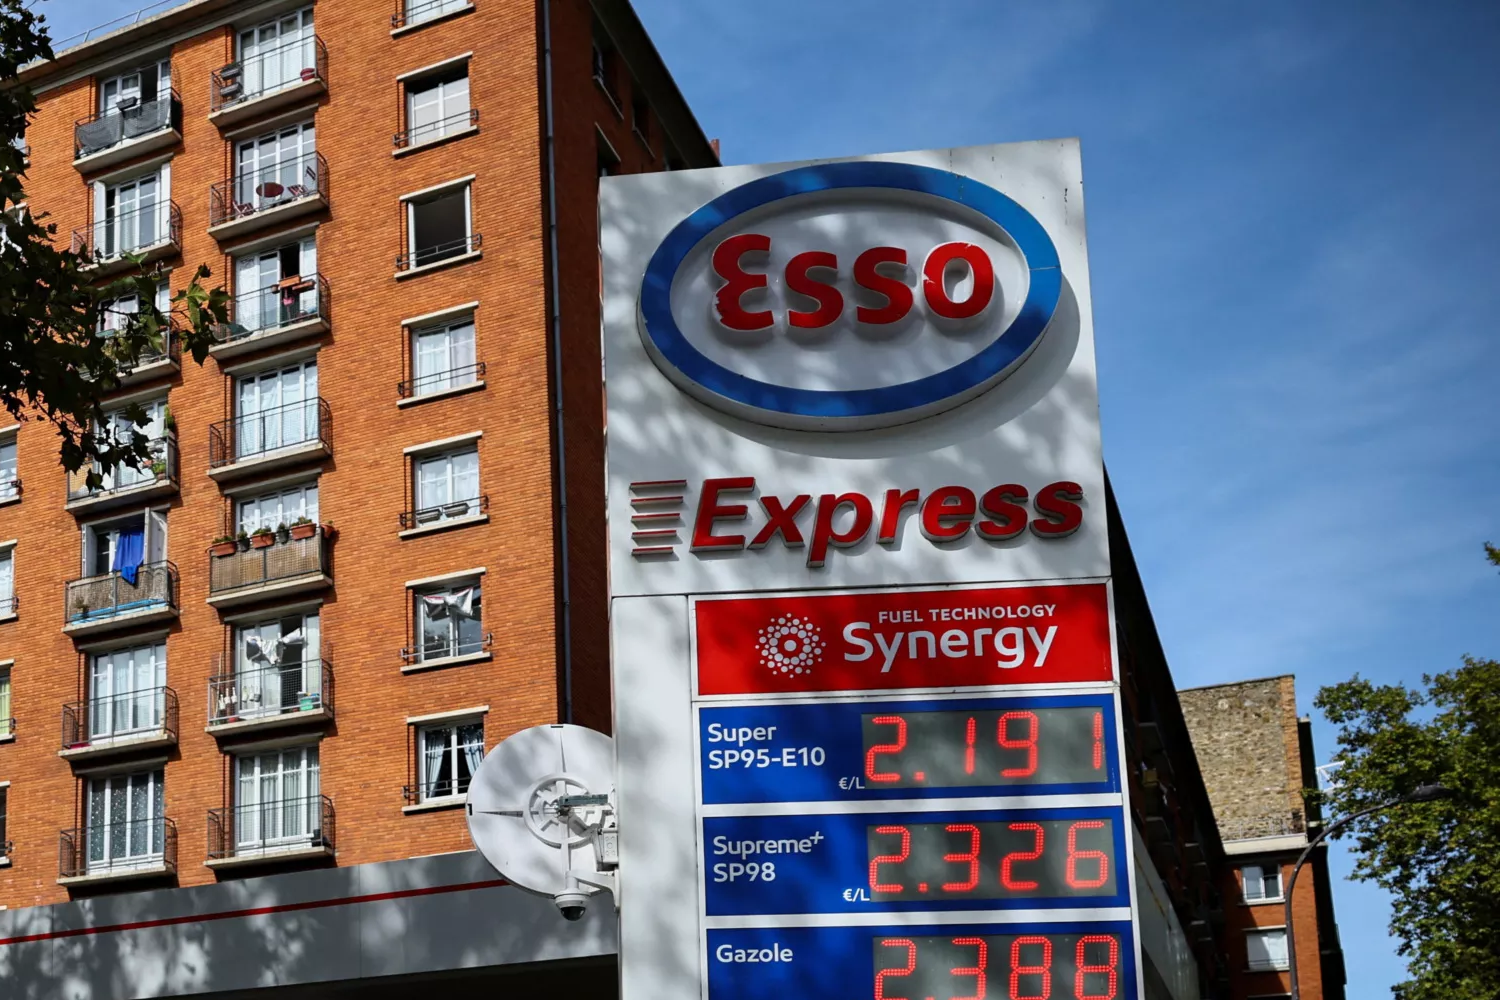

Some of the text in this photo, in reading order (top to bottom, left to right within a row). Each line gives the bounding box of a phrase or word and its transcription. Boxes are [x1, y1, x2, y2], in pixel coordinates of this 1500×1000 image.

[711, 233, 995, 331] Esso
[690, 476, 1085, 568] Express
[878, 604, 1057, 624] FUEL TECHNOLOGY
[842, 622, 1059, 673] Synergy
[707, 723, 777, 746] Super
[865, 710, 1102, 782] 2.191
[708, 747, 826, 769] SP95-E10
[838, 775, 865, 790] €/L
[868, 821, 1109, 893] 2.326
[713, 862, 776, 882] SP98
[843, 887, 870, 902] €/L
[716, 943, 793, 963] Gazole
